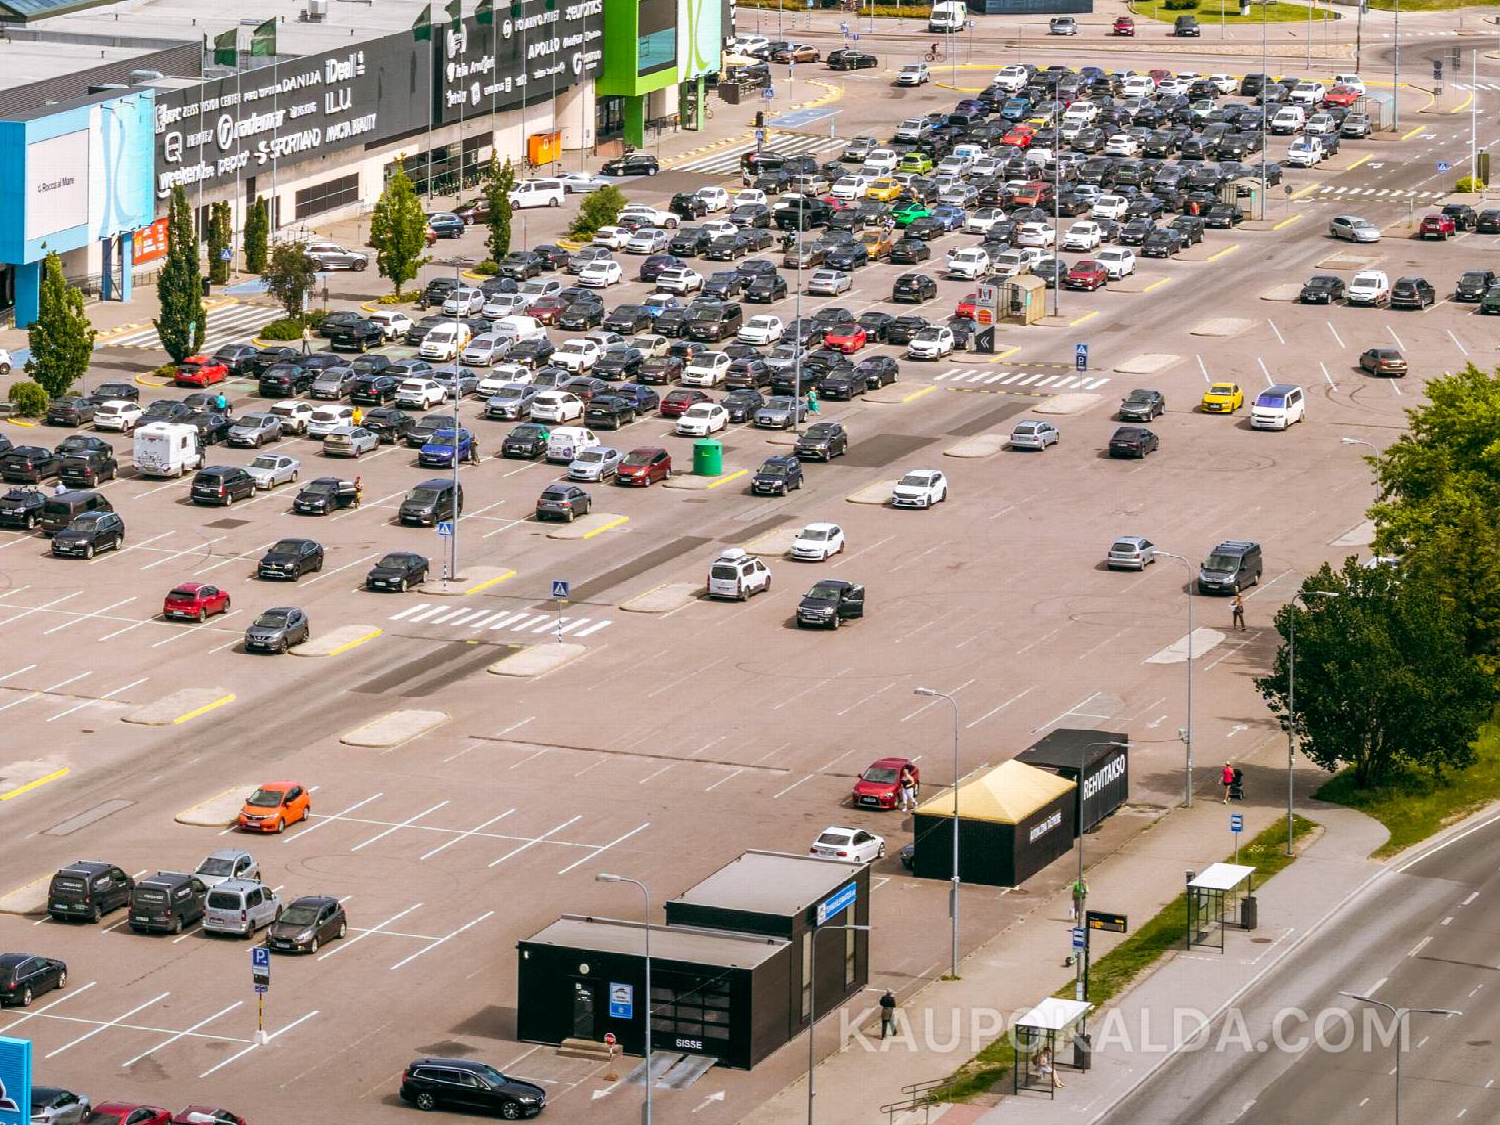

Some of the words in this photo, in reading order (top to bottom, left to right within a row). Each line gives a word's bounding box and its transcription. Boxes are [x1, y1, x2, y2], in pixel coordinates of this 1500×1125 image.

[527, 38, 560, 60] APOLLO
[324, 87, 352, 114] ILU
[270, 127, 321, 160] SPORTLAND
[1083, 754, 1126, 801] REHVITAKSO
[256, 949, 265, 963] P
[676, 1038, 703, 1049] SISSE
